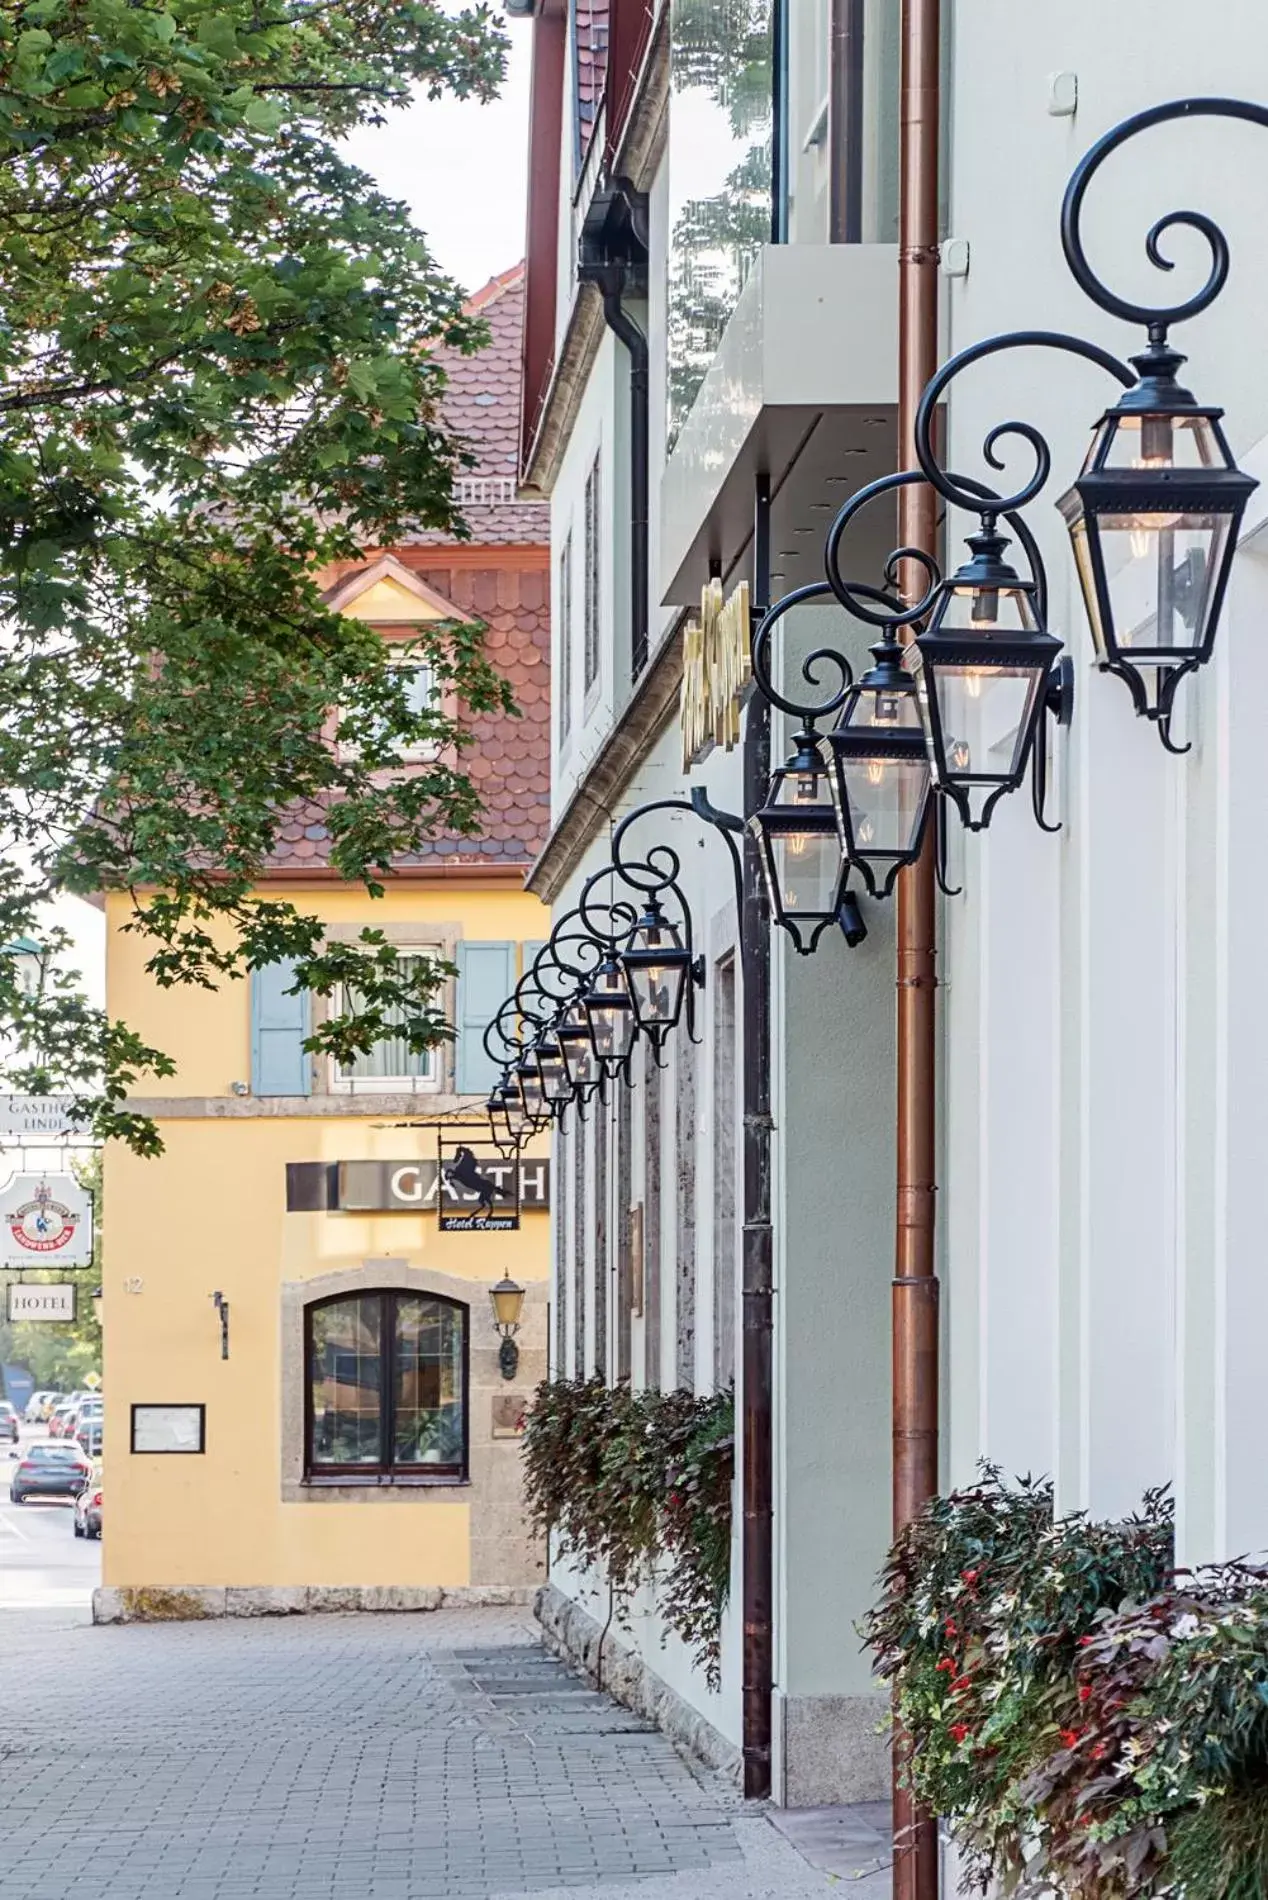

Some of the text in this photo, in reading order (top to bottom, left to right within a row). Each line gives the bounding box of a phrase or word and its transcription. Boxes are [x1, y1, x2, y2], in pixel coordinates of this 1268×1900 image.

[25, 1118, 63, 1129] LINDE
[445, 1217, 473, 1229] Hotel
[15, 1296, 68, 1309] HOTEL
